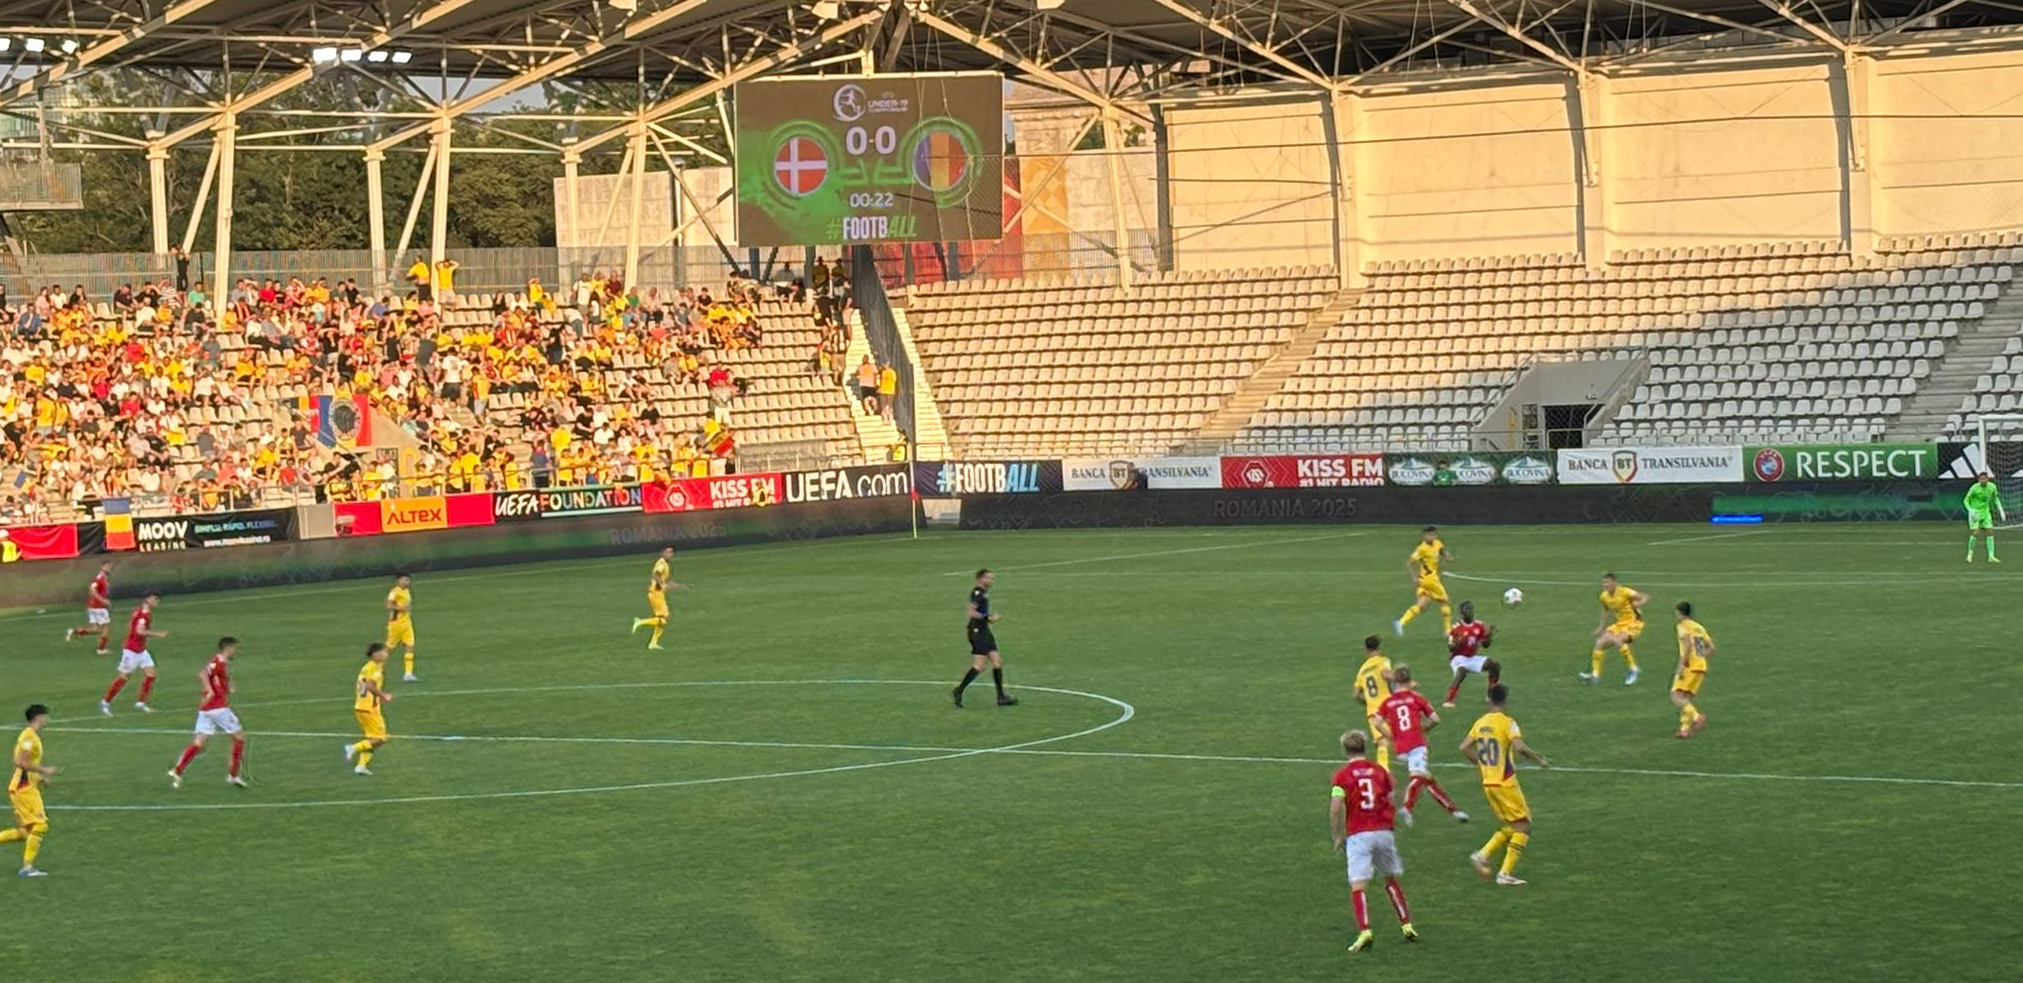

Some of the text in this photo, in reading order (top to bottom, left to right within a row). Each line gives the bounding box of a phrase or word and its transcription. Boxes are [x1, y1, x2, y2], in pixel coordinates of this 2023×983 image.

[850, 193, 894, 208] 00:22
[826, 215, 917, 240] #FOOTBALL
[1071, 468, 1106, 479] BANCA
[1113, 468, 1127, 478] BT
[1297, 457, 1384, 478] KISS FM
[1568, 457, 1729, 470] BANCA BT TRANSILVANIA
[1796, 450, 1927, 478] RESPECT
[710, 477, 775, 500] KISS FM
[786, 470, 909, 503] UEFA.com
[937, 462, 1040, 494] #FOOTBALL
[495, 493, 539, 516] UEFA
[540, 488, 641, 511] FOUNDATION
[1213, 499, 1358, 518] ROMANIA 2025
[138, 521, 188, 541] MOOV
[610, 521, 727, 546] ROMANIA 2025
[139, 541, 186, 552] LEASING
[1366, 676, 1378, 698] 8
[1397, 705, 1411, 732] 8
[1476, 737, 1498, 767] 20
[1358, 778, 1374, 810] 3
